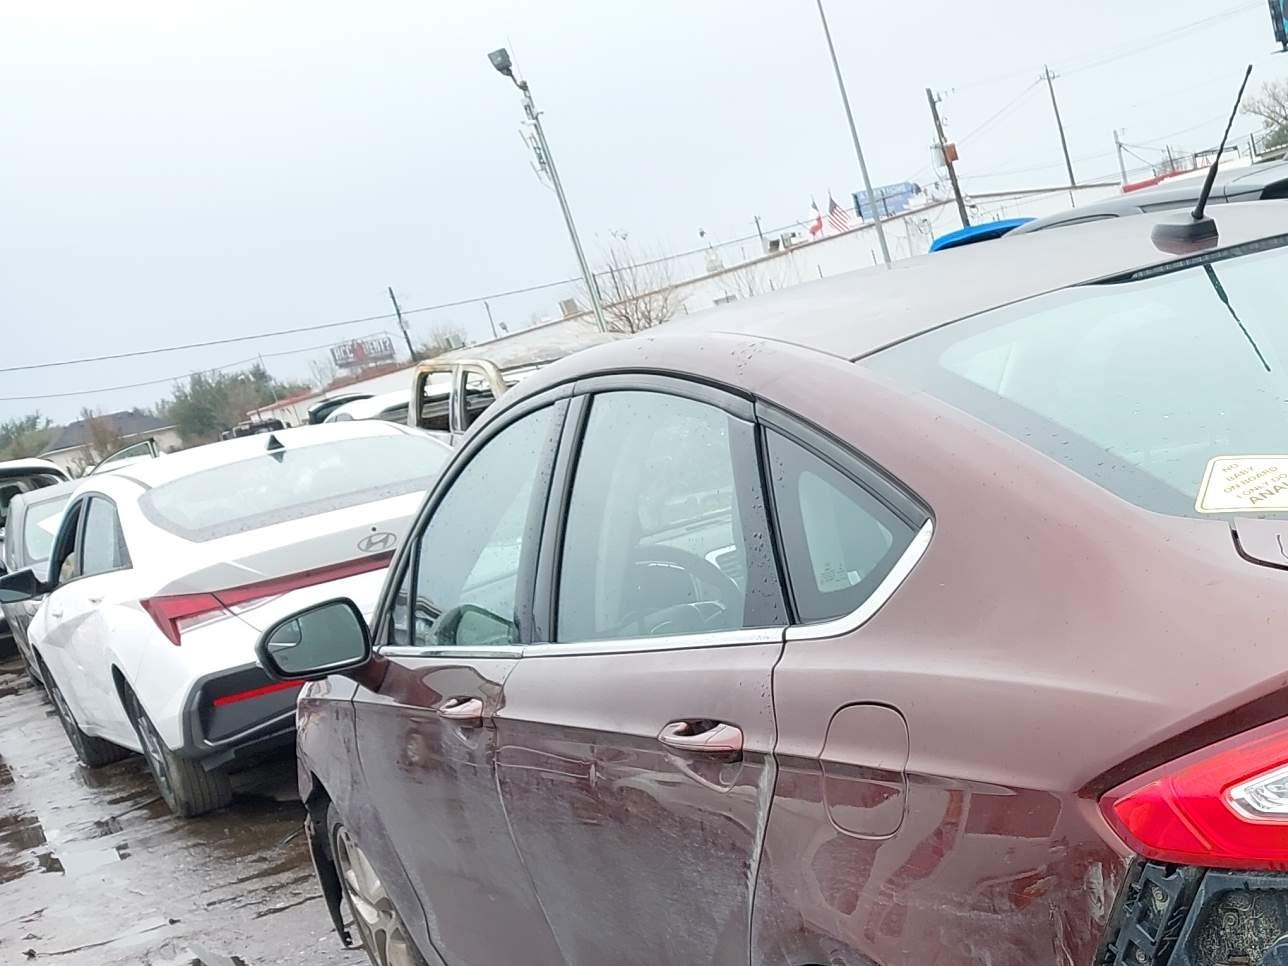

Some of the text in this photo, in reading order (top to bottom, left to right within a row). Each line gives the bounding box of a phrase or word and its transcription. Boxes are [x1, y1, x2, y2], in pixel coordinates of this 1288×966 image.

[1222, 463, 1240, 473] NO
[1226, 465, 1254, 482] BABY
[1223, 465, 1279, 494] ON BOARD
